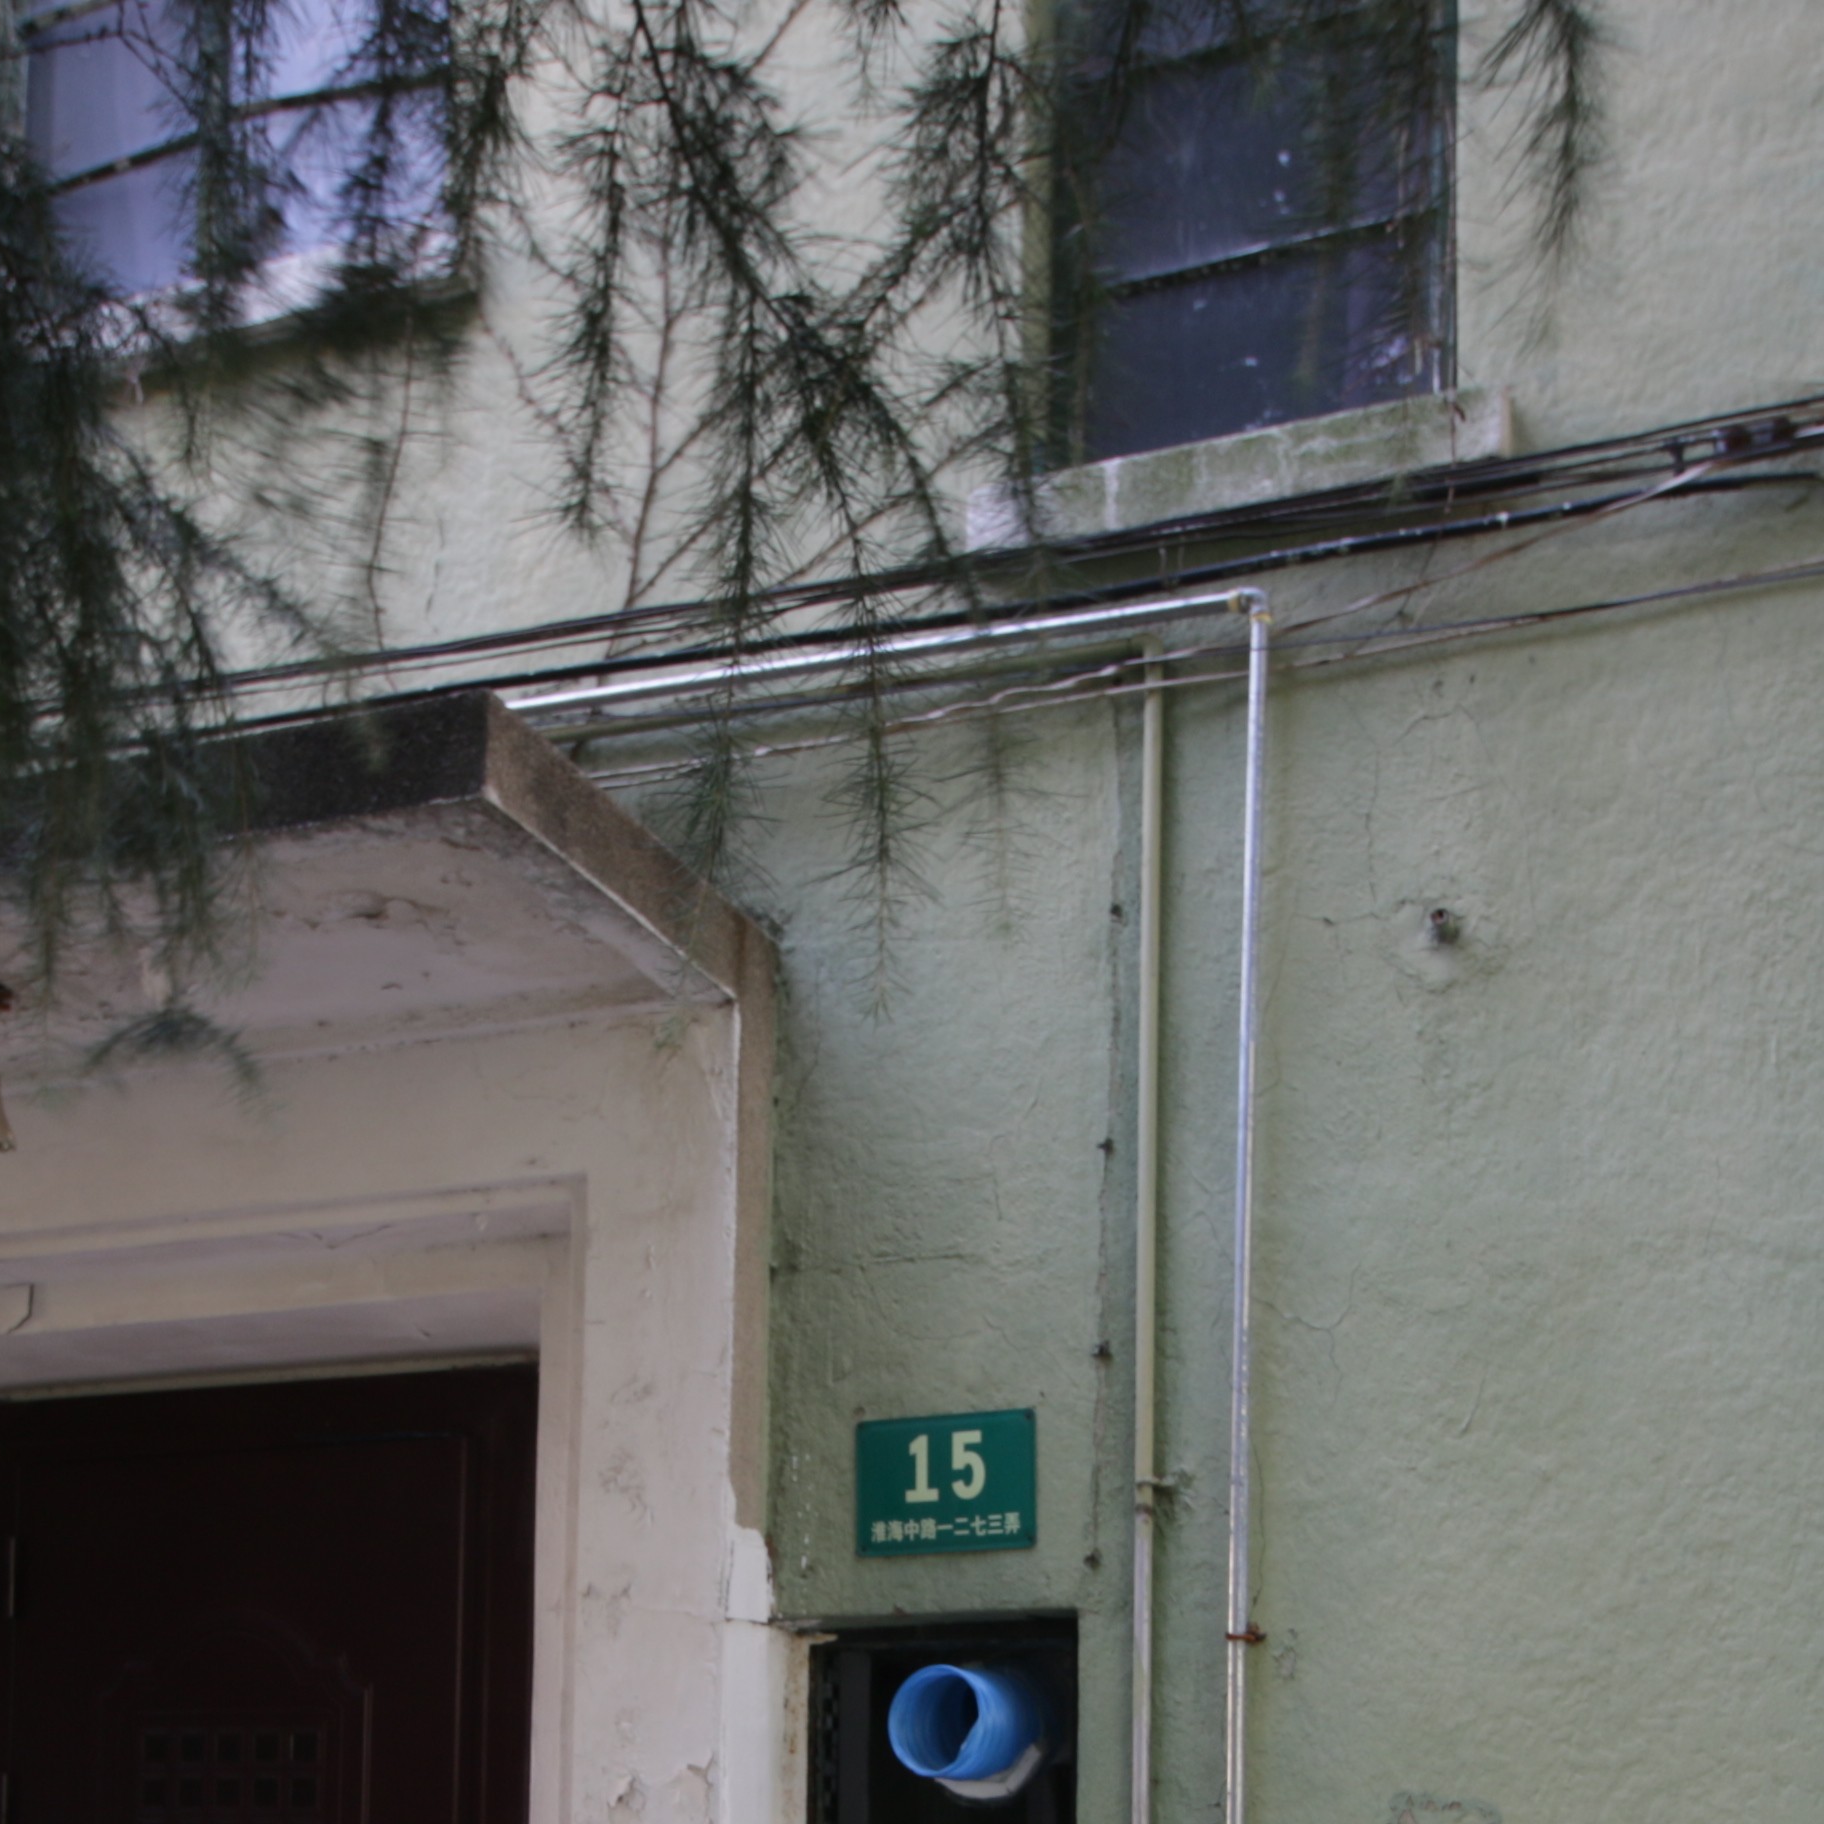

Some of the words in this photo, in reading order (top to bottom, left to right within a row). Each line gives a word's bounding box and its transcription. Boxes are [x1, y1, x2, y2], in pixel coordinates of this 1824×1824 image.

[905, 1429, 986, 1503] 15
[871, 1512, 1021, 1543] 淮海中路一二七三弄
